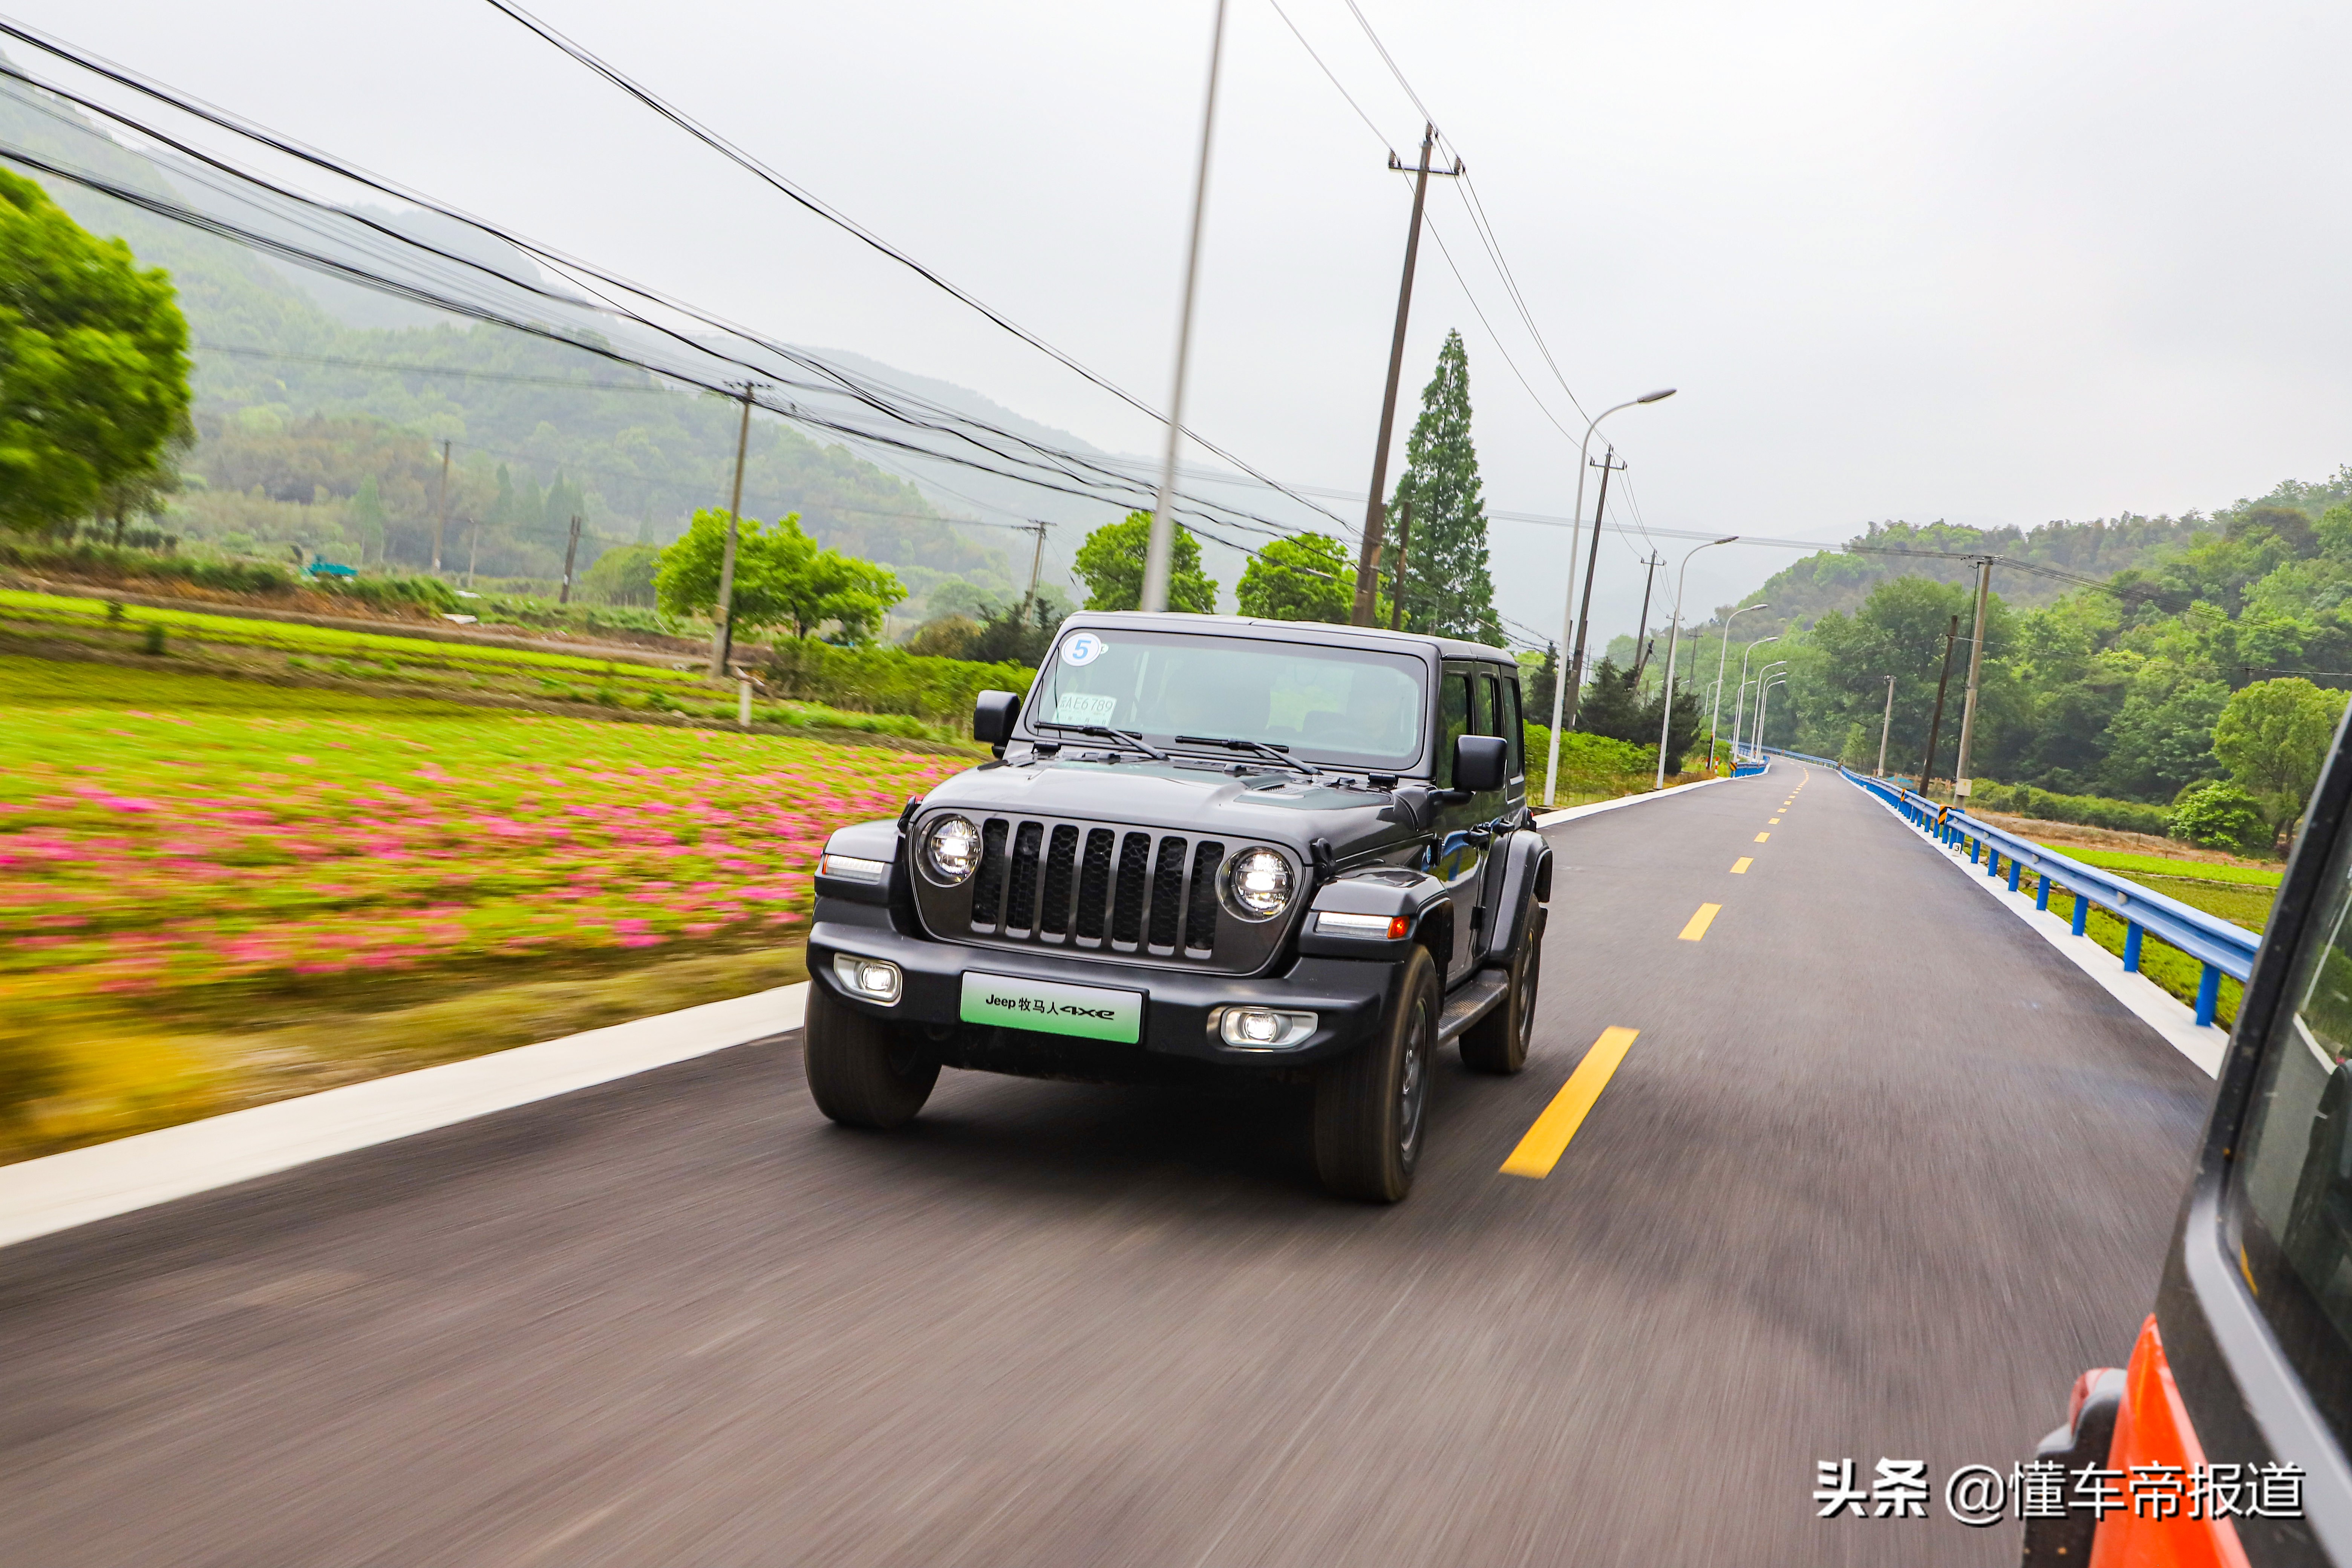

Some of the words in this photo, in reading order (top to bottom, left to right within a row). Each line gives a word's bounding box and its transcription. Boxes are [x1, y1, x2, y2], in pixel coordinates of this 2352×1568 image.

[1073, 639, 1091, 659] 5
[986, 994, 1016, 1010] Jeep
[1019, 997, 1058, 1015] 牧马人
[1060, 1006, 1115, 1020] 4xe
